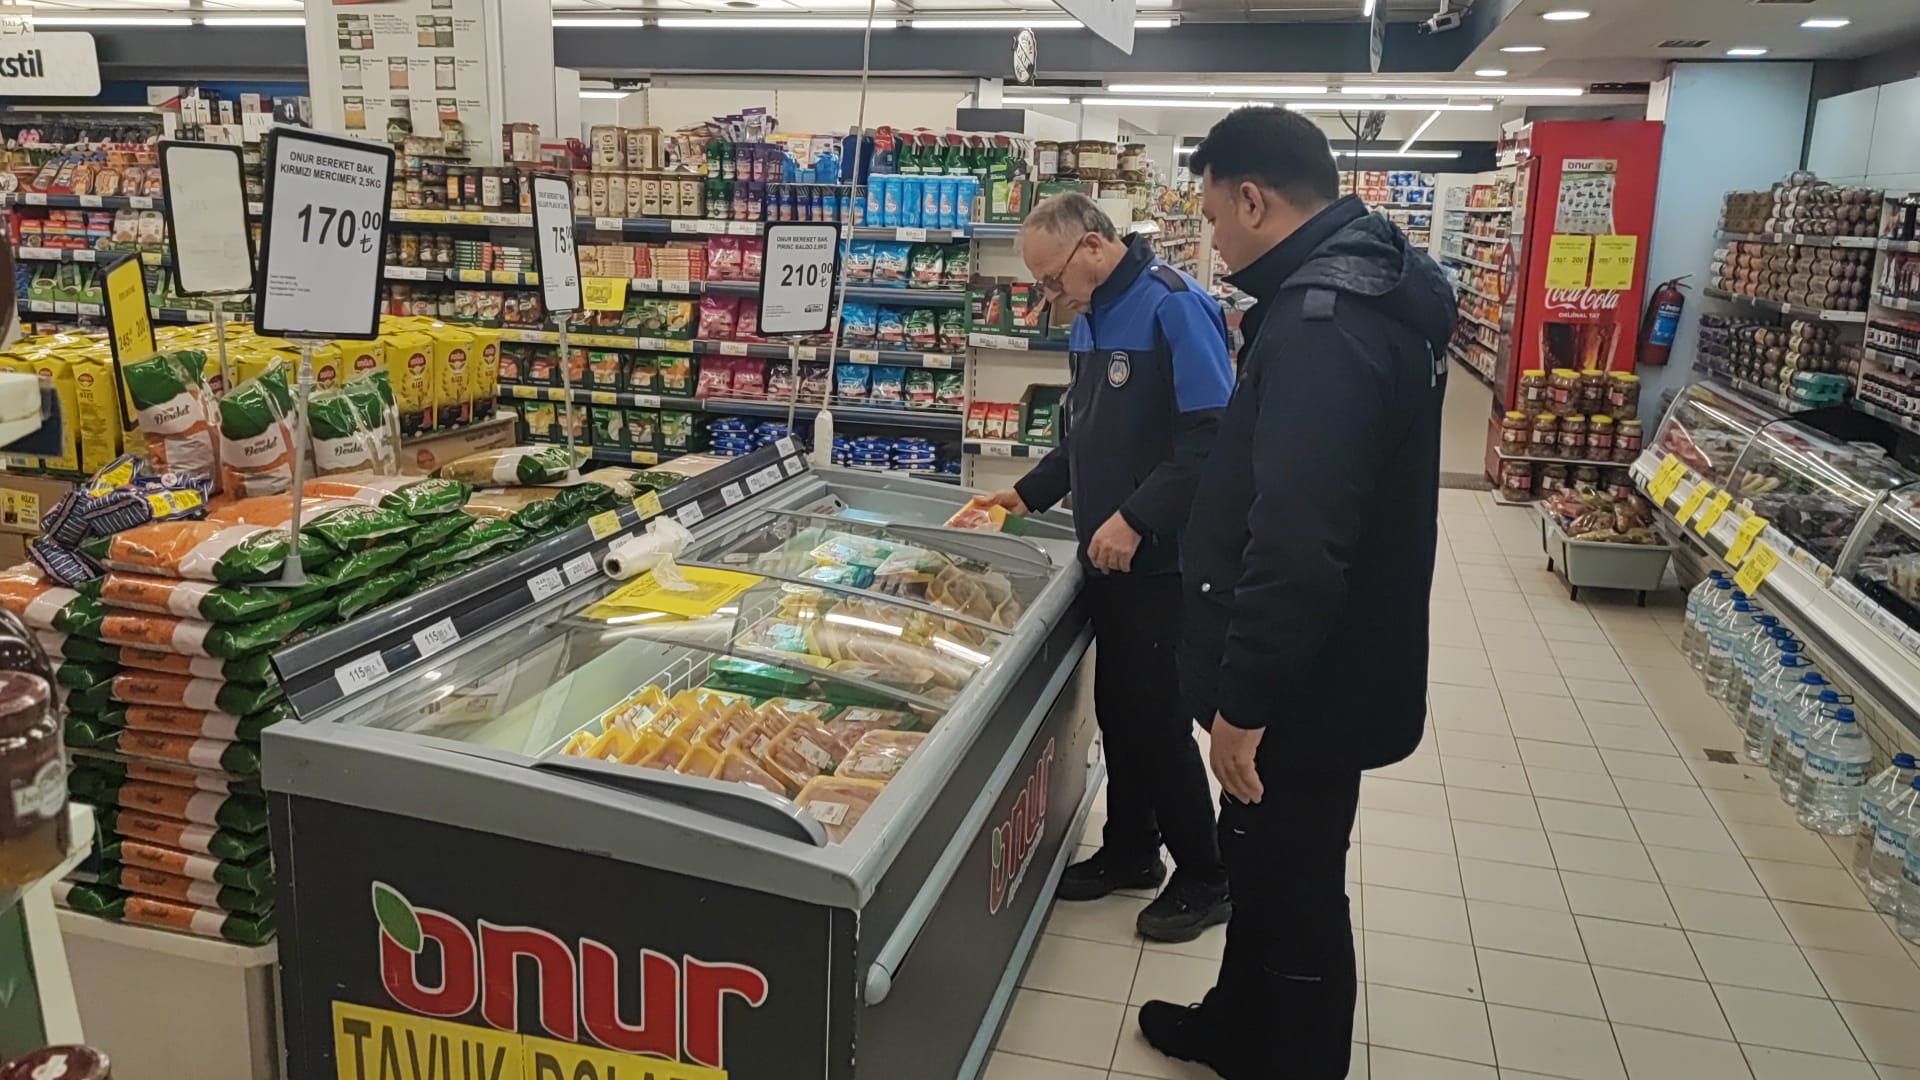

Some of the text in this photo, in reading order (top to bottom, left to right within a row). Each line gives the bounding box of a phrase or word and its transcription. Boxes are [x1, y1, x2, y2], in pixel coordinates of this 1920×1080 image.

[281, 164, 311, 177] KIRMIZI
[314, 169, 357, 184] MERCIMEK
[290, 151, 375, 175] ONUR BEREKET BAK.
[990, 737, 1055, 915] onur
[378, 900, 768, 1069] onur
